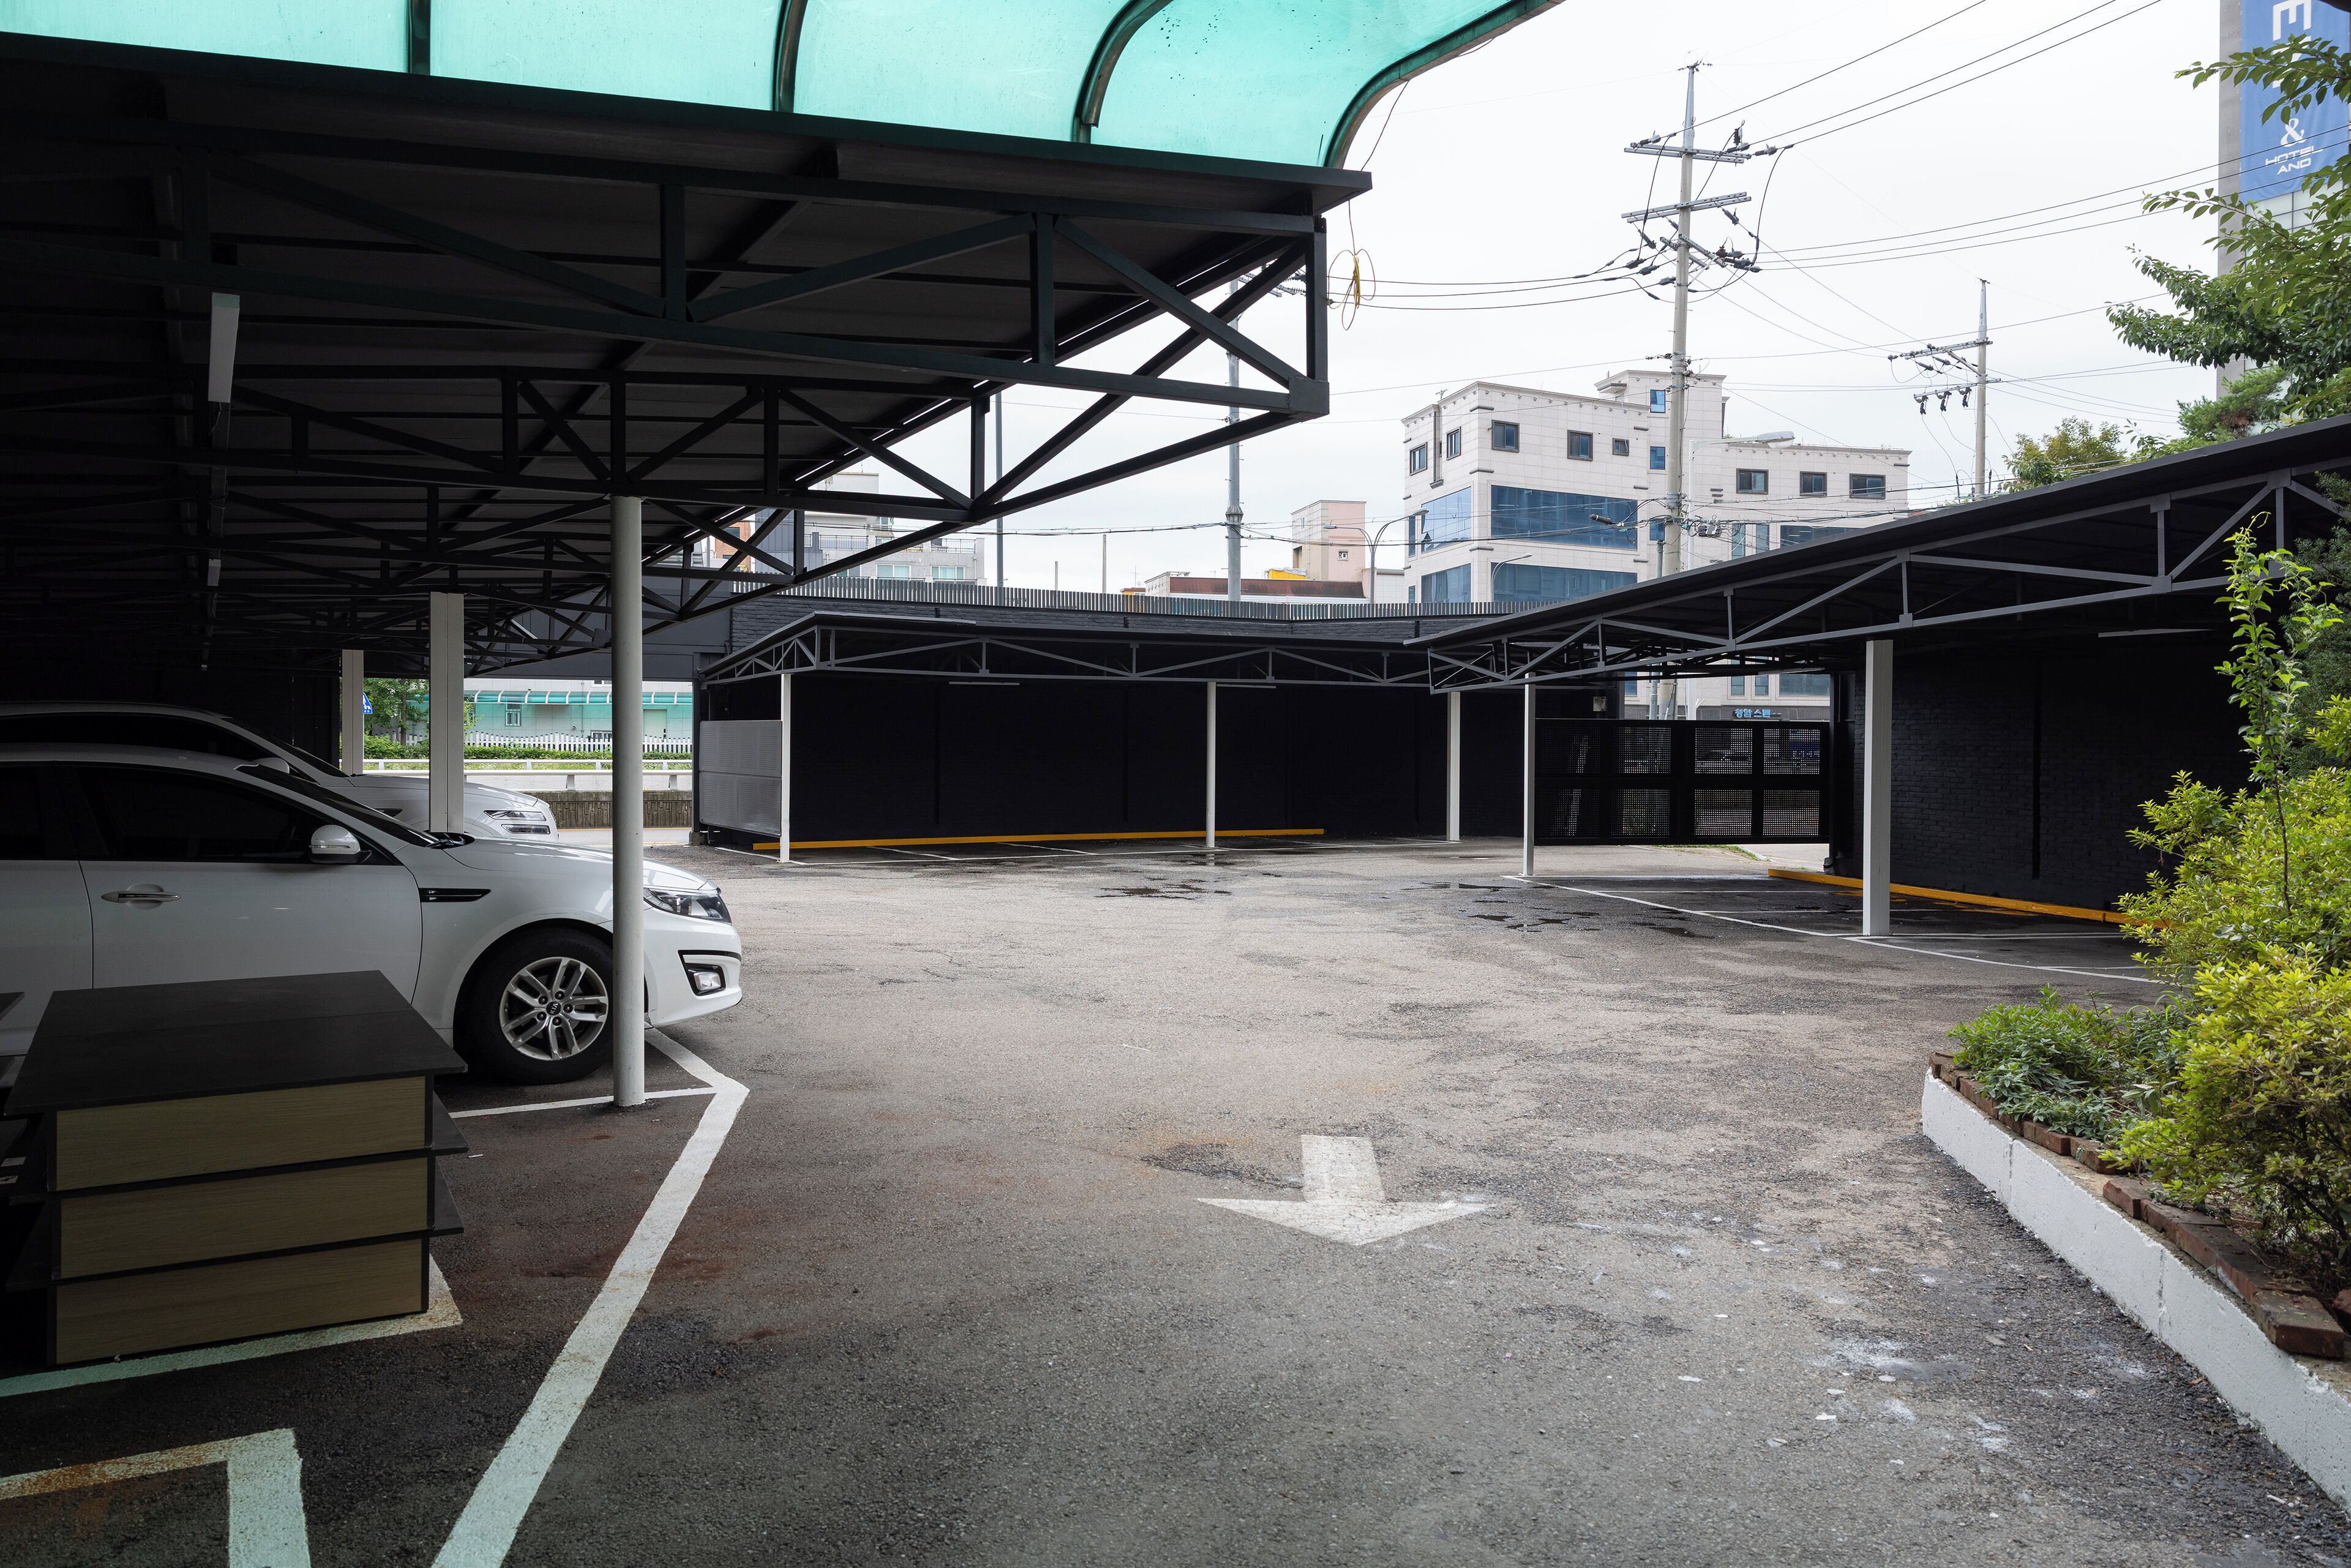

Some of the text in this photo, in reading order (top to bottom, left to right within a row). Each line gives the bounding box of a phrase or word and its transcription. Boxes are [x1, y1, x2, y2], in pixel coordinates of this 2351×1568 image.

[2281, 118, 2307, 147] &
[2265, 146, 2323, 167] HOTEL
[2277, 157, 2312, 174] AND
[549, 1003, 558, 1015] KIA
